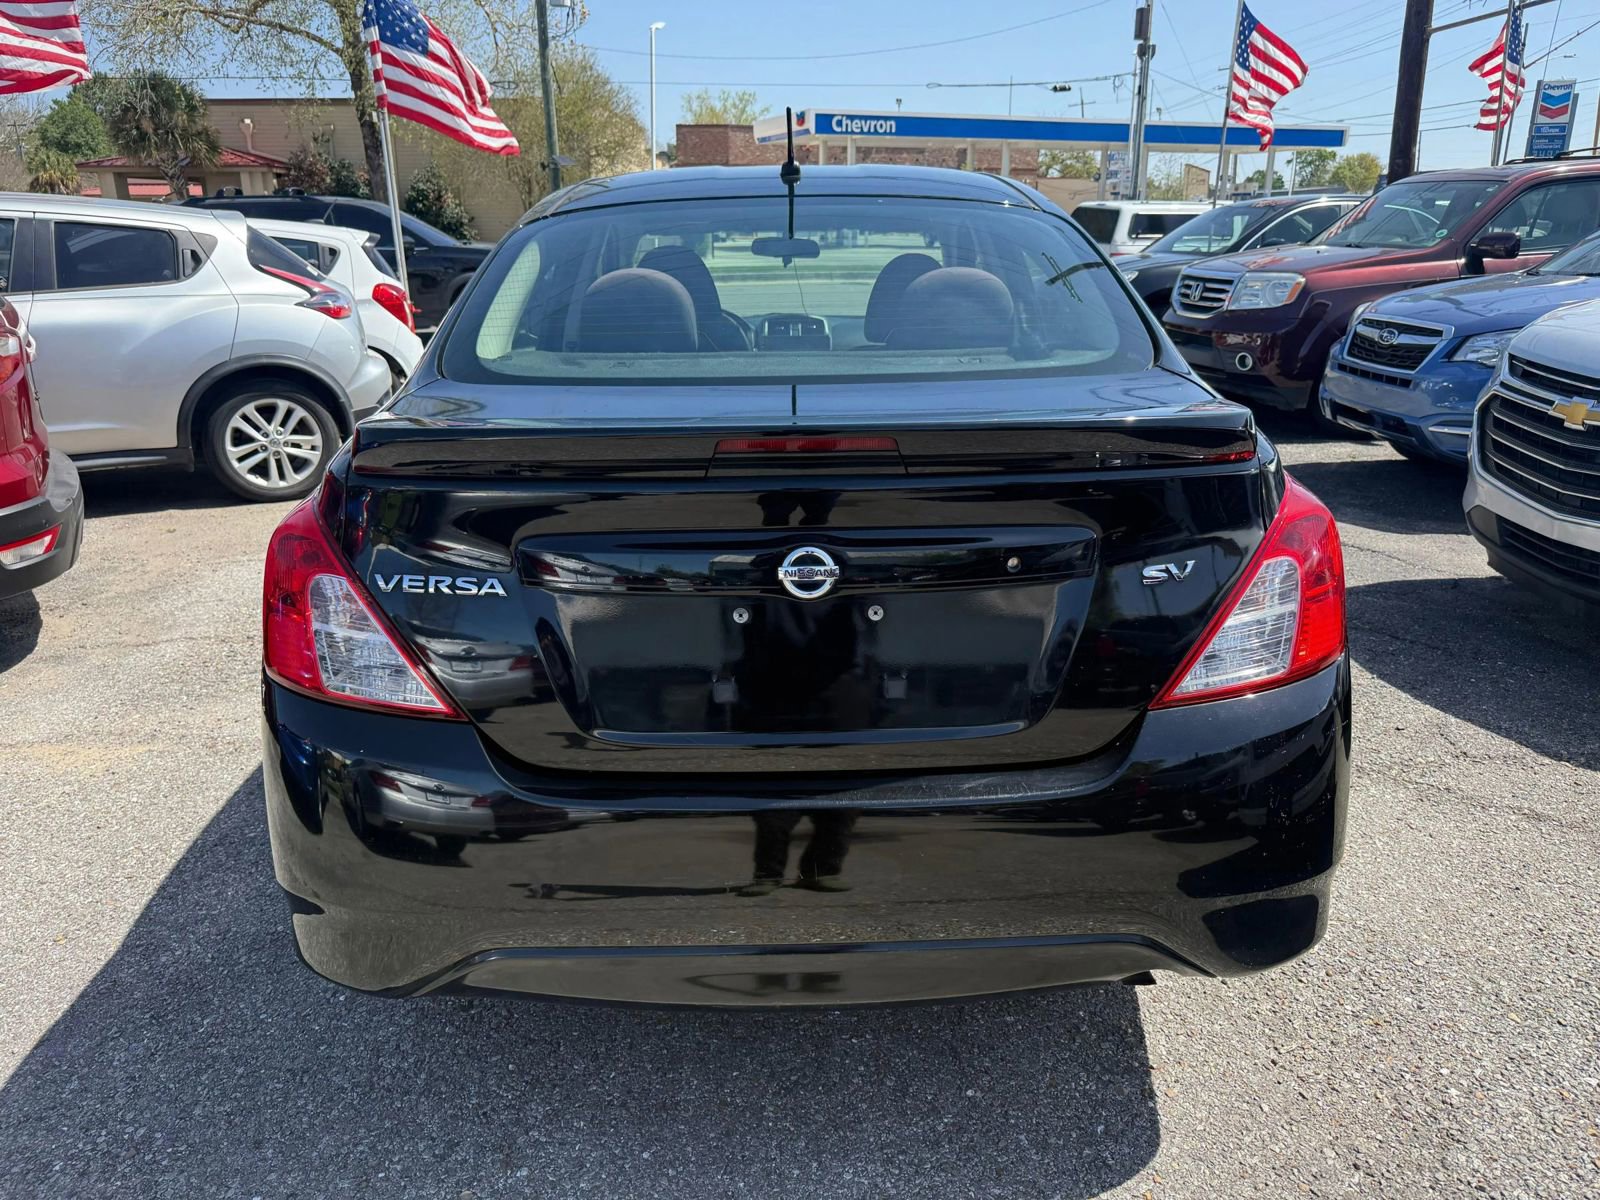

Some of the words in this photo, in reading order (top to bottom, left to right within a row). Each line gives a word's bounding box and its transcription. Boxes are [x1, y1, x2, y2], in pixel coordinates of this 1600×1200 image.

[1543, 83, 1573, 91] Chevron
[831, 115, 896, 133] Chevron
[783, 568, 833, 578] NISSAN
[1142, 560, 1196, 585] SV
[374, 573, 508, 597] VERSA
